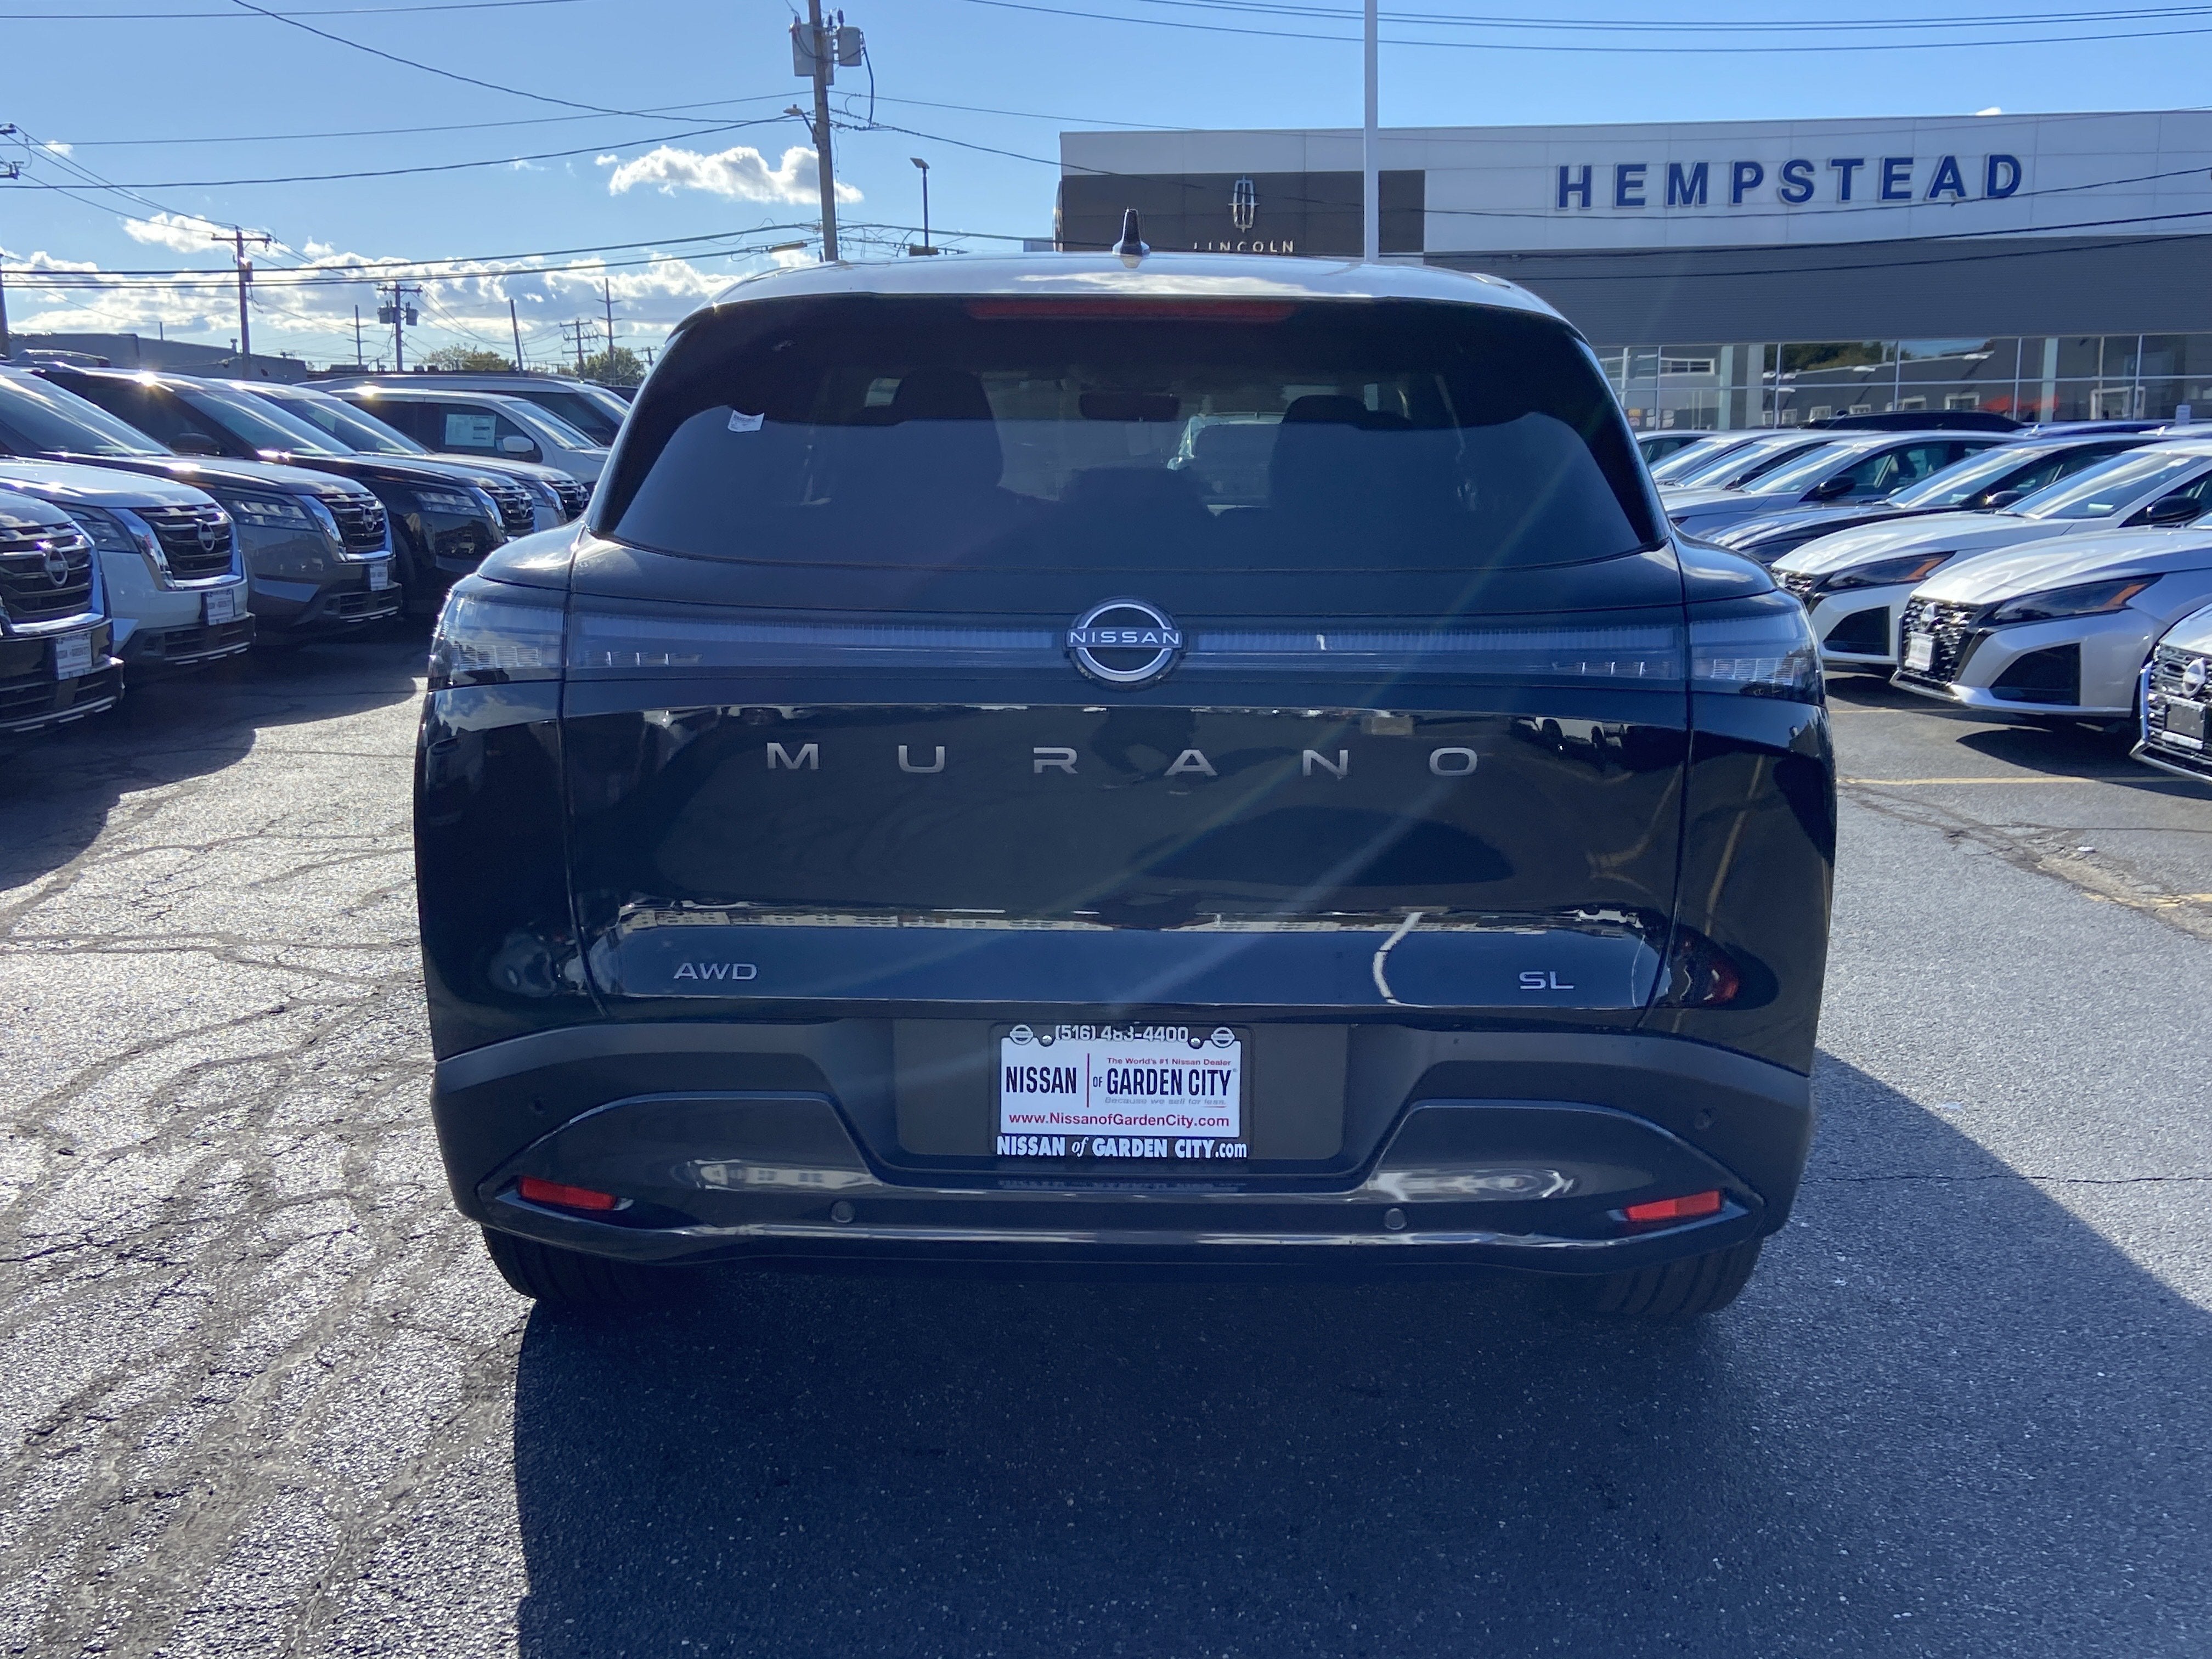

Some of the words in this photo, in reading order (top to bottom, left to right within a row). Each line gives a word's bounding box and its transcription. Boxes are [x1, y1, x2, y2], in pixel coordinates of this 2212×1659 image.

[1555, 153, 2023, 211] HEMPSTEAD
[1070, 631, 1179, 644] NISSAN
[766, 742, 1479, 777] MURANO
[673, 962, 758, 980] AWD
[1519, 970, 1575, 989] SL
[1056, 1025, 1097, 1041] (516)
[1107, 1057, 1122, 1065] The
[1125, 1057, 1157, 1065] World's
[1006, 1066, 1077, 1094] NISSAN
[1092, 1076, 1103, 1087] OF
[1107, 1068, 1182, 1096] GARDEN
[1188, 1069, 1232, 1096] CITY
[1009, 1112, 1229, 1128] www.NissanofGardenCity.com
[997, 1135, 1065, 1156] NISSAN
[1071, 1137, 1089, 1158] of
[1092, 1137, 1167, 1158] GARDEN
